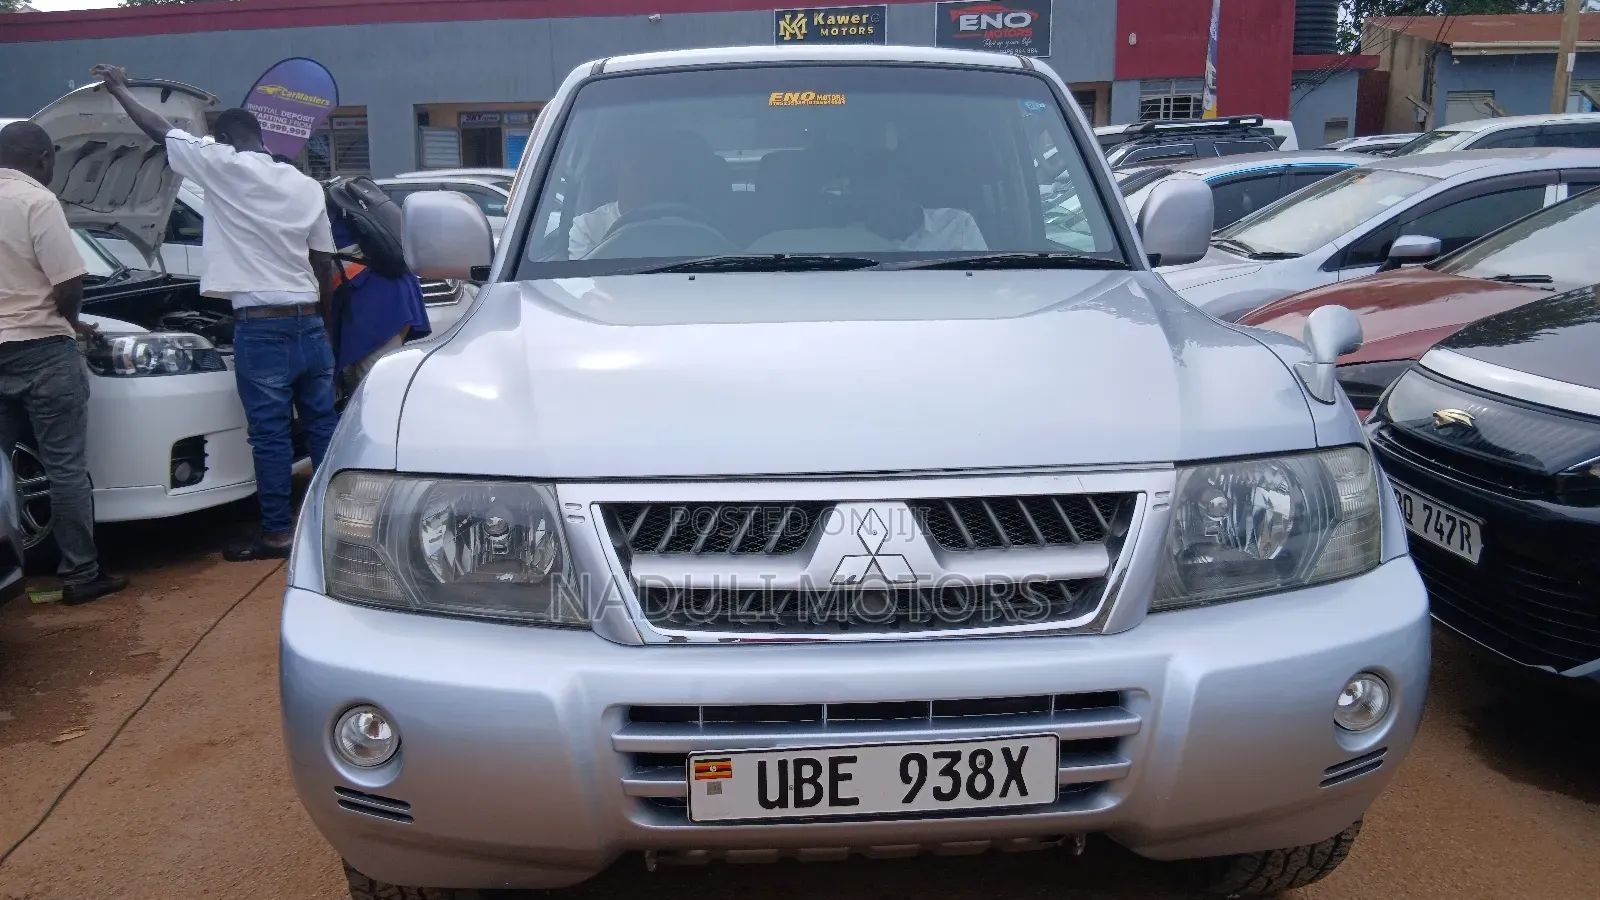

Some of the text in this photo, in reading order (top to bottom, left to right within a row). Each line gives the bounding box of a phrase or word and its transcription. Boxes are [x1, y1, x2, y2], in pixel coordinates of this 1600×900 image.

[959, 12, 1032, 31] ENO
[820, 26, 874, 37] MOTORS
[983, 28, 1032, 38] MOTORS
[281, 89, 330, 105] CarMasters
[769, 91, 816, 102] ENO
[281, 110, 315, 123] DEPOSIT
[288, 118, 313, 130] FROM
[1422, 502, 1472, 555] 747R
[757, 745, 1029, 810] UBE 938X
